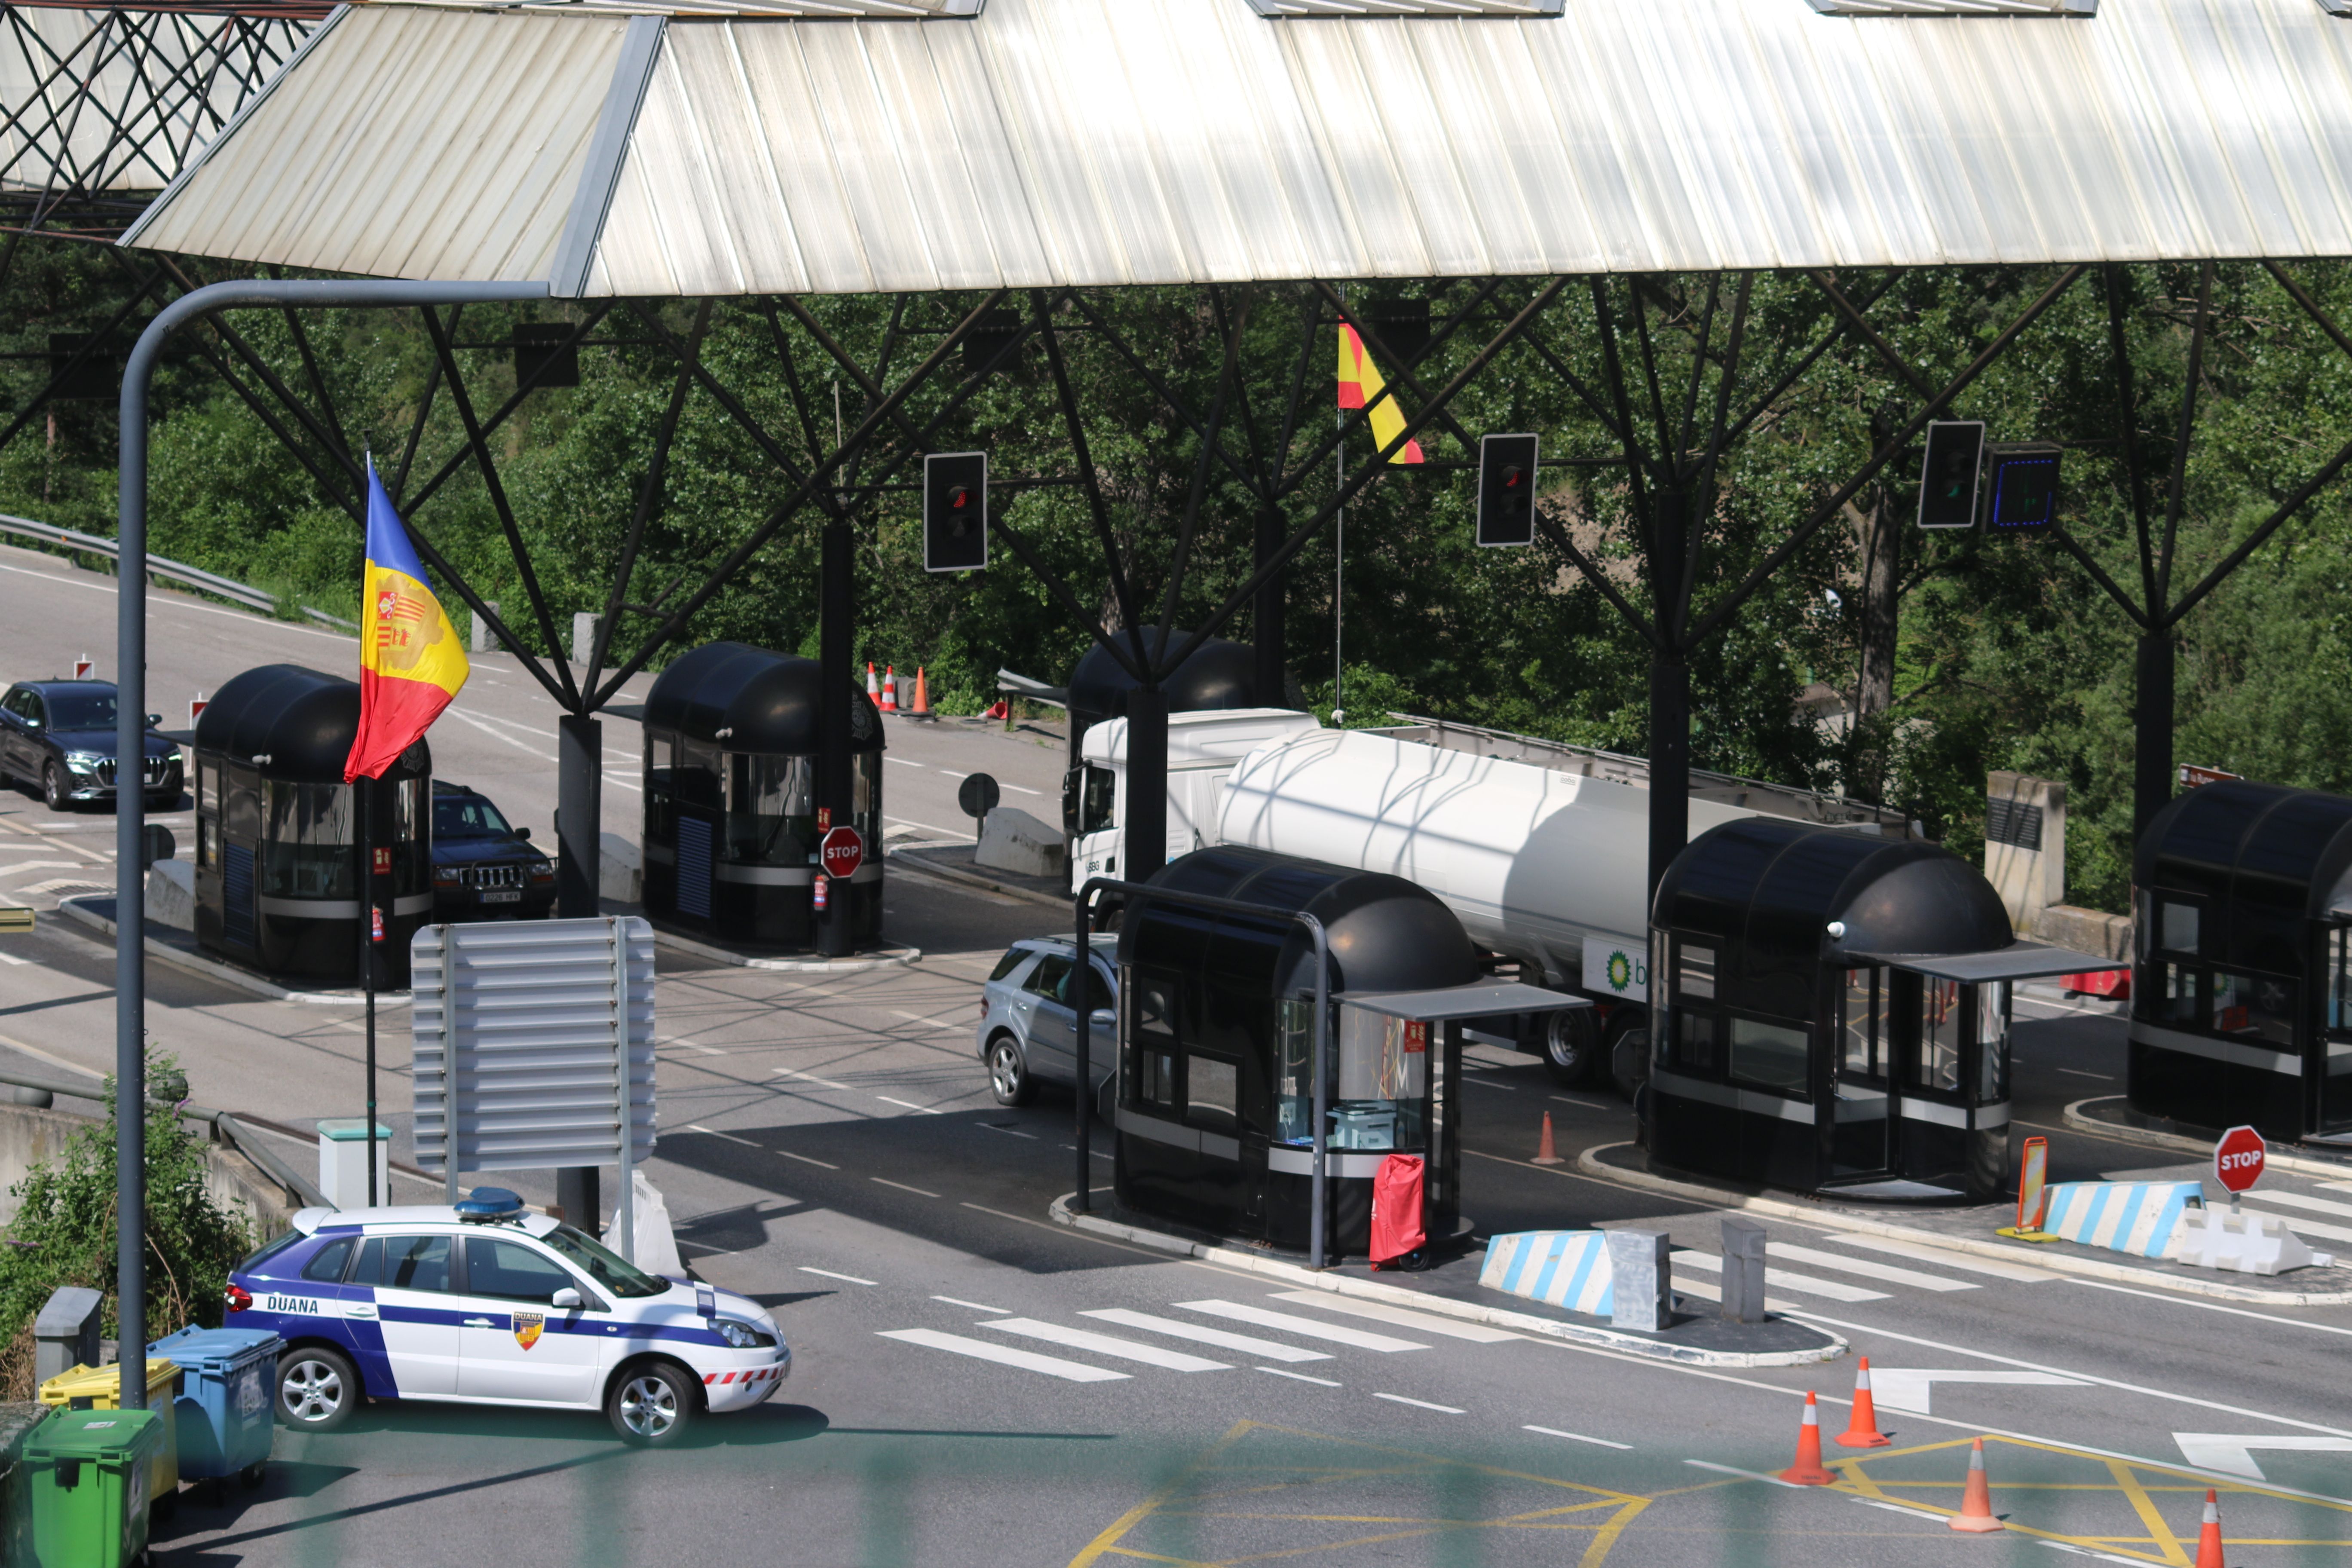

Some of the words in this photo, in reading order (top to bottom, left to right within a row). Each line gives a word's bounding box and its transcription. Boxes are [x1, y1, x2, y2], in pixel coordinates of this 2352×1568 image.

[827, 846, 858, 859] STOP
[1089, 861, 1099, 872] SBG
[1636, 958, 1647, 985] b
[2221, 1150, 2262, 1170] STOP
[267, 1296, 318, 1314] DUANA
[515, 1312, 542, 1321] DUANA
